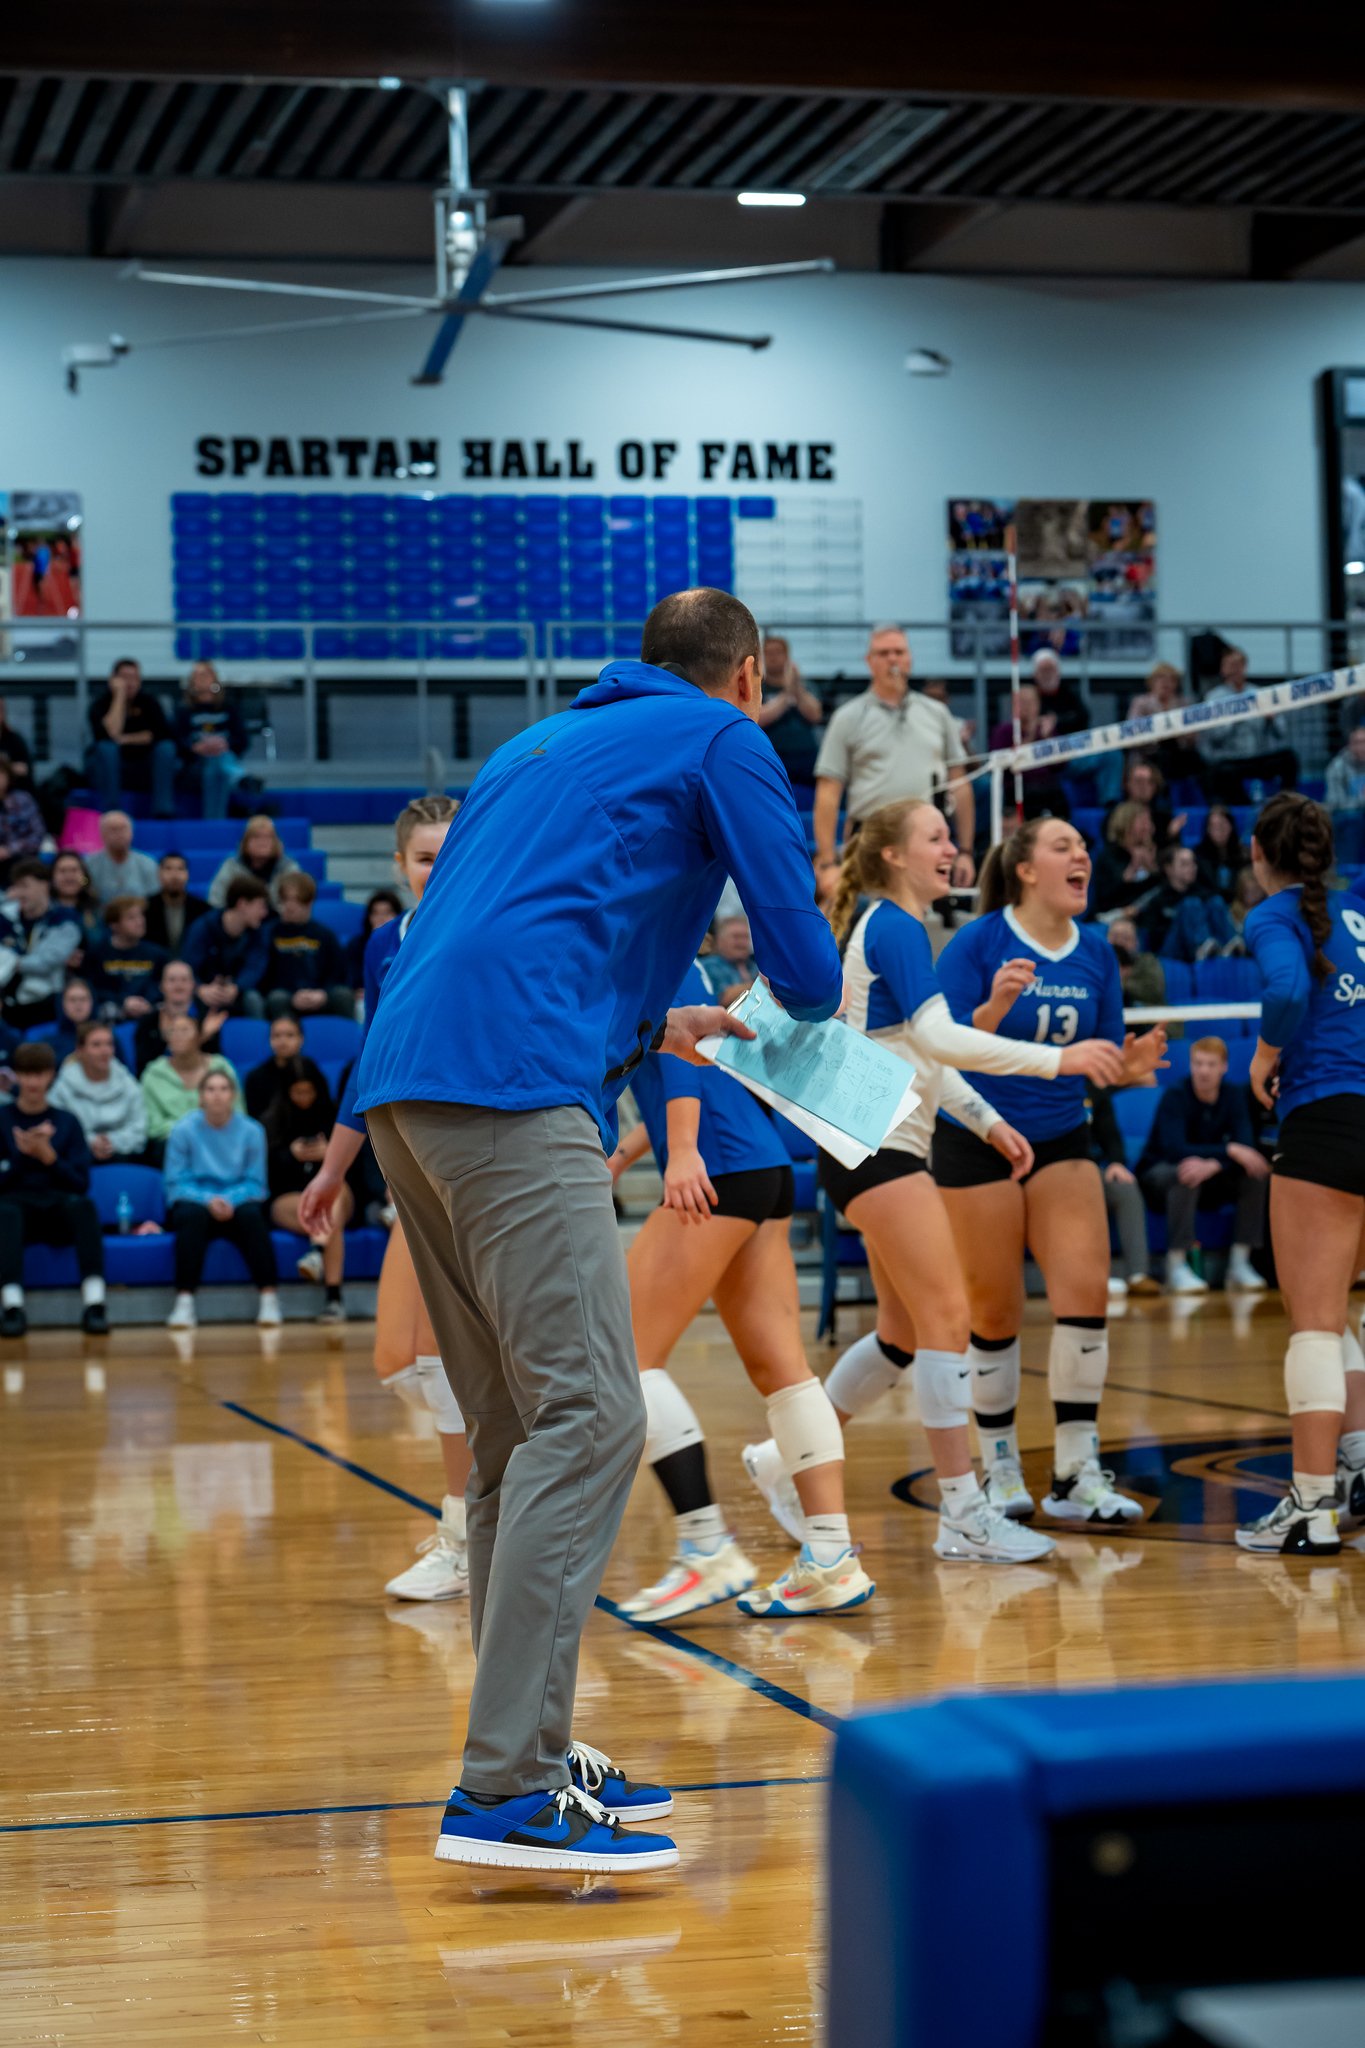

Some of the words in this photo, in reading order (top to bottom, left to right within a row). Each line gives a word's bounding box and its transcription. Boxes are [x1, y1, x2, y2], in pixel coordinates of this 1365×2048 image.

[196, 437, 438, 477] SPARTAN
[462, 439, 594, 478] HALL
[619, 440, 678, 479] OF
[701, 441, 835, 480] FAME
[1021, 976, 1089, 1000] Aurora
[1033, 1003, 1080, 1046] 13
